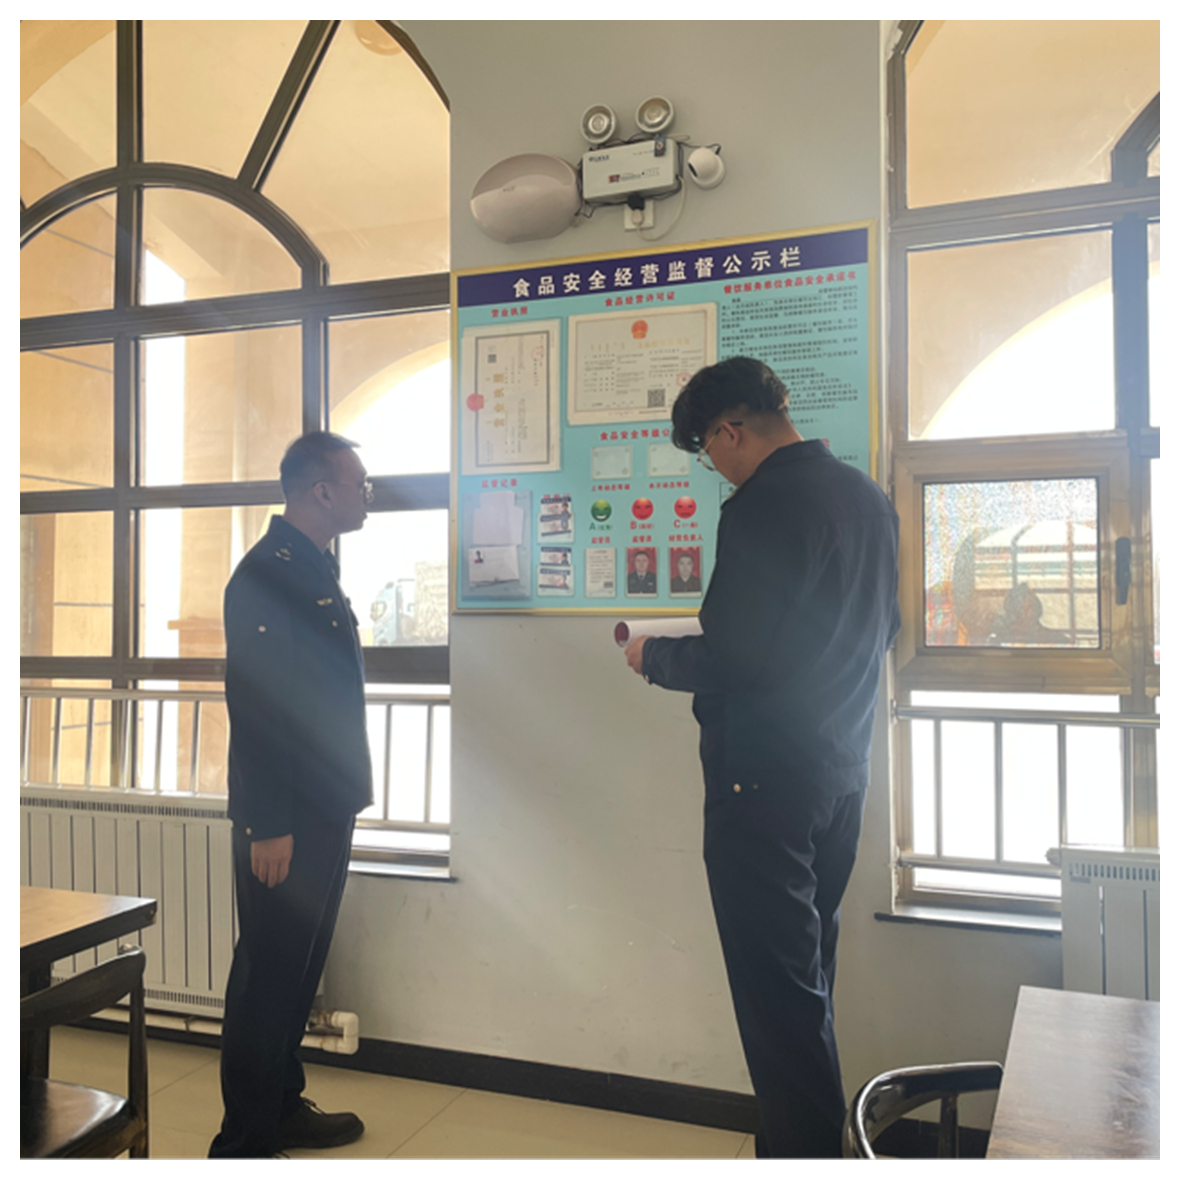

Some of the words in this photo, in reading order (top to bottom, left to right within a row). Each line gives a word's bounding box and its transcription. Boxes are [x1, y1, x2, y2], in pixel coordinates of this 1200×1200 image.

[513, 246, 802, 298] 食品安全经营监督公示栏
[723, 270, 857, 295] 餐饮服务单位食品安全承诺书
[605, 291, 676, 307] 食品经营许可证
[491, 306, 529, 318] 营业执照
